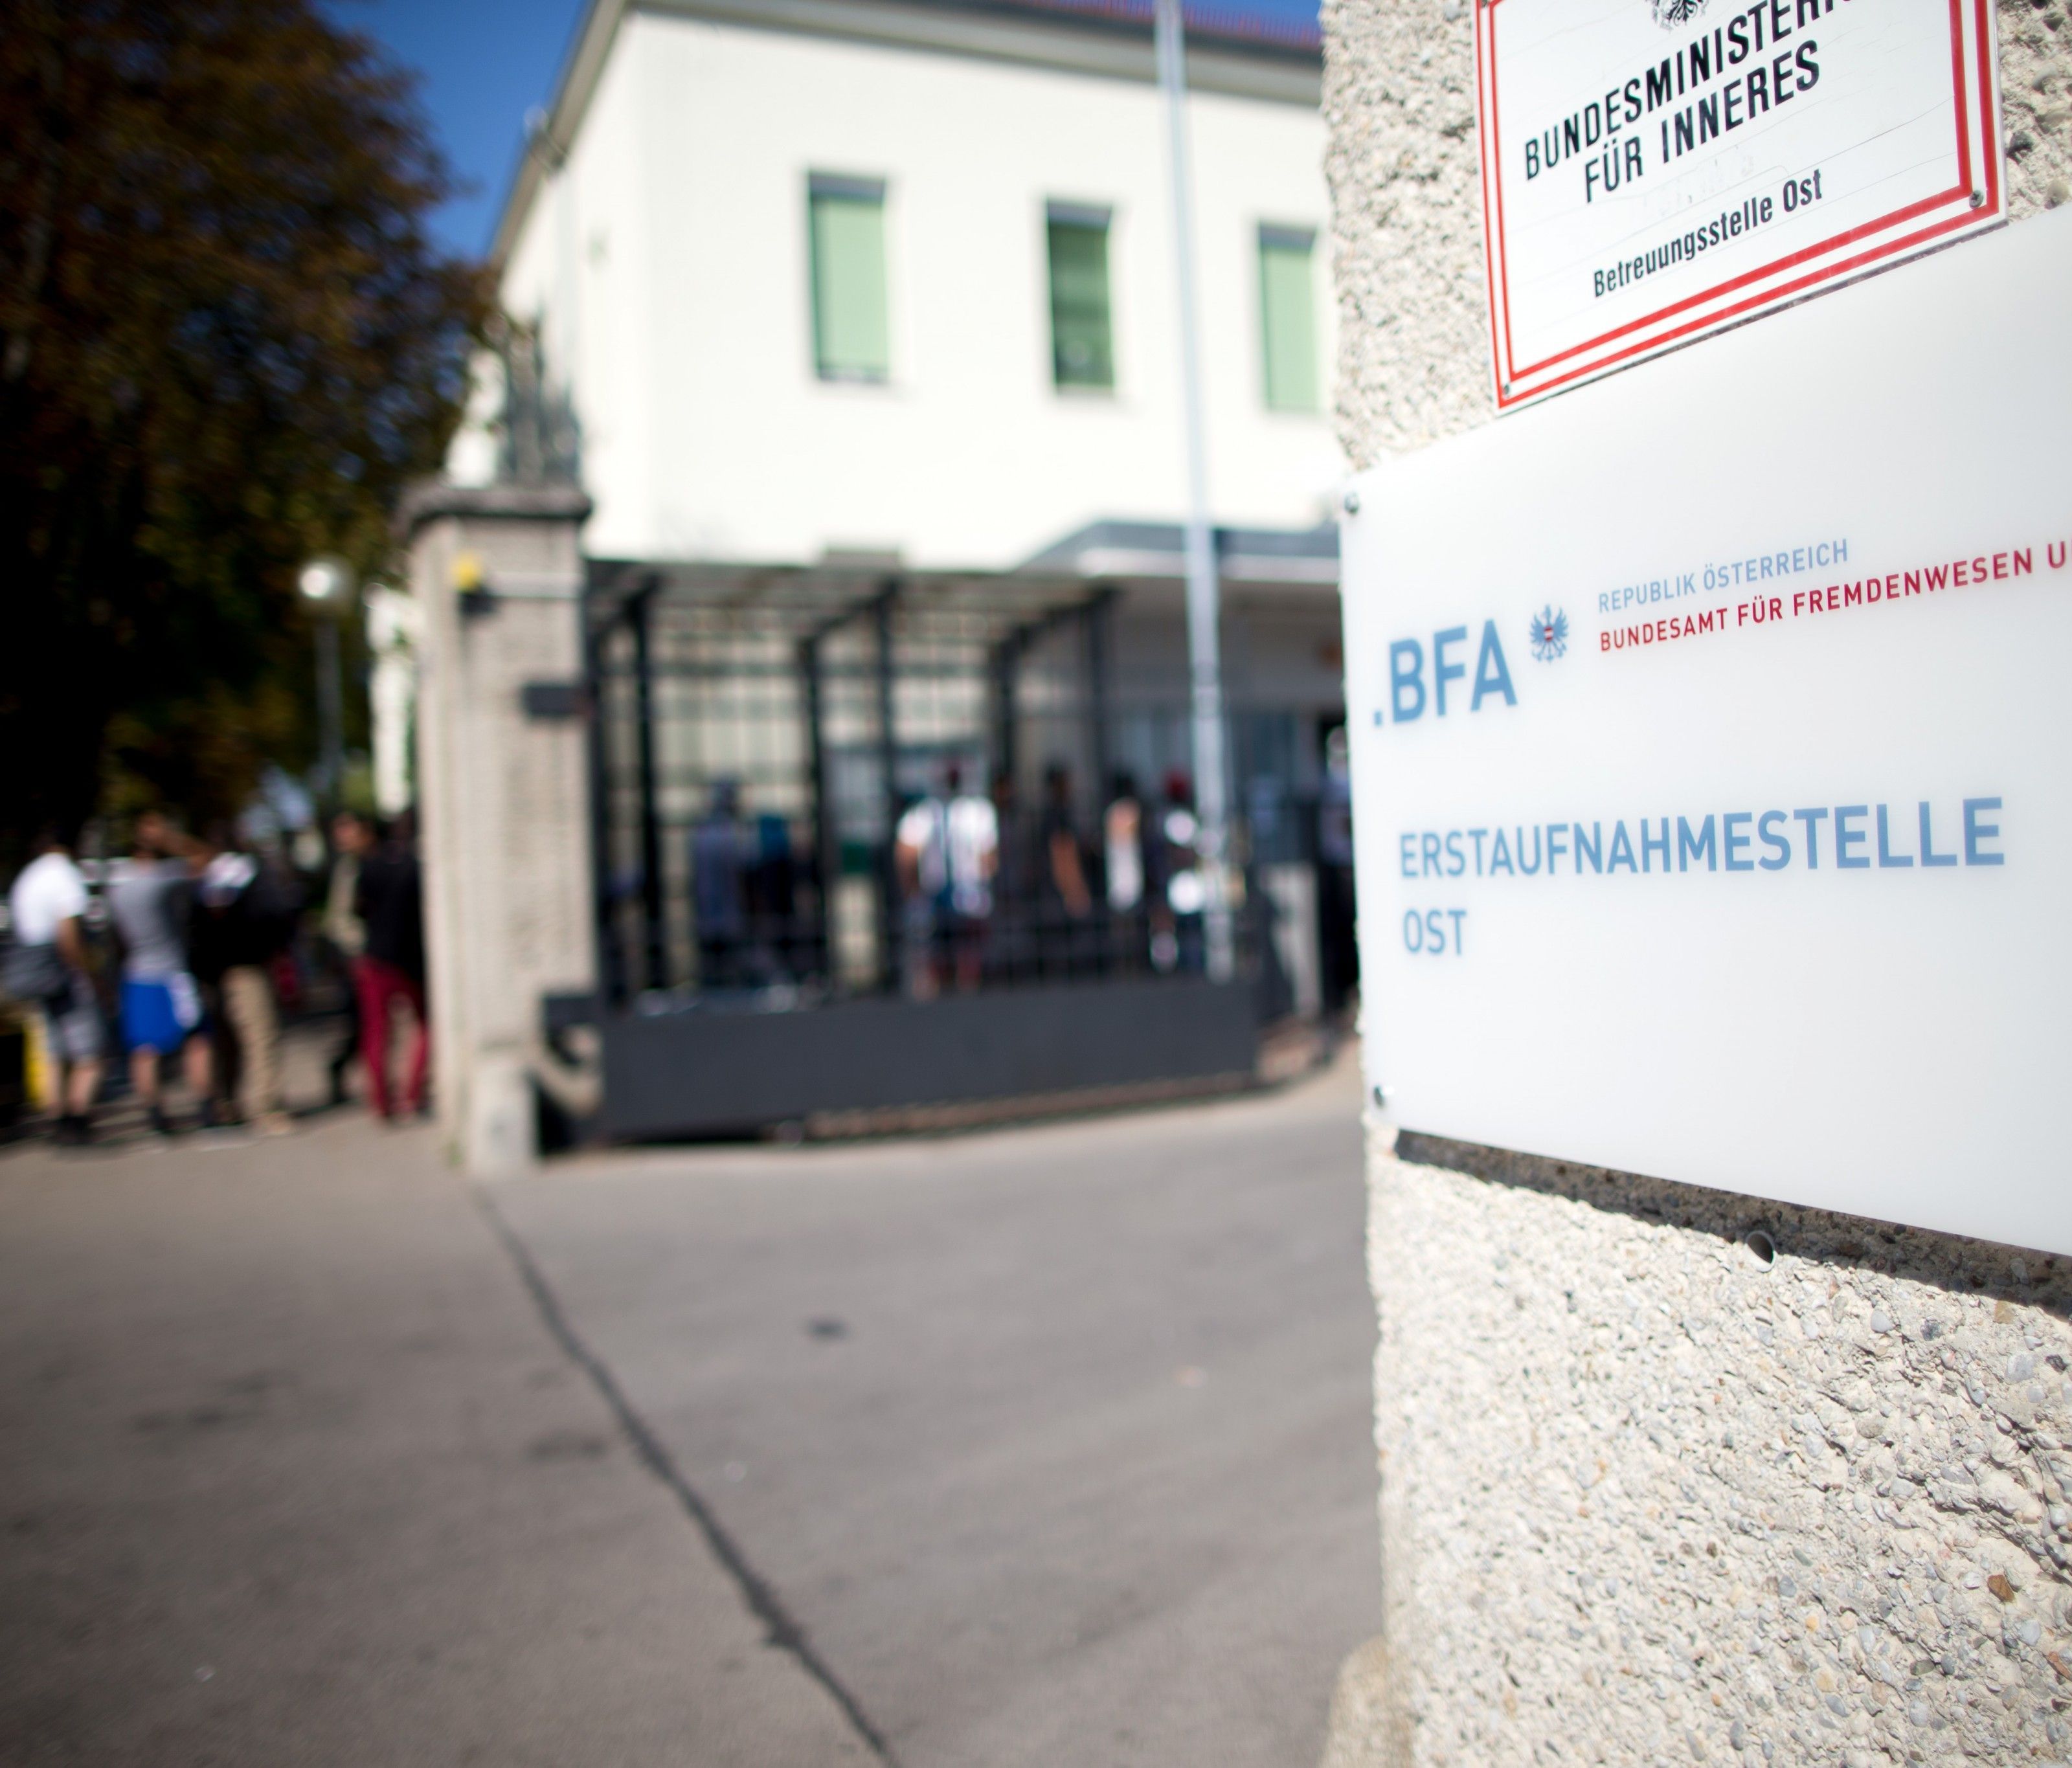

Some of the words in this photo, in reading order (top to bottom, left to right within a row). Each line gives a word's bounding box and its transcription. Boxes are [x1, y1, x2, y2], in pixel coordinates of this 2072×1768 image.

[1526, 0, 1852, 181] BUNDESMINISTER
[1584, 135, 1644, 203] FÜR
[1661, 39, 1820, 164] INNERES
[1593, 197, 1774, 298] Betreuungsstelle
[1783, 169, 1823, 212] Ost
[1598, 573, 1696, 613] REPUBLIK
[1702, 538, 1849, 592] ÖSTERREICH
[1600, 608, 1728, 652] BUNDESAMT
[1737, 593, 1784, 627] FÜR
[1792, 548, 2033, 617] FREMDENWESEN
[2047, 540, 2072, 569] U
[1400, 796, 2005, 878] ERSTAUFNAHMESTELLE
[1402, 908, 1468, 956] OST
